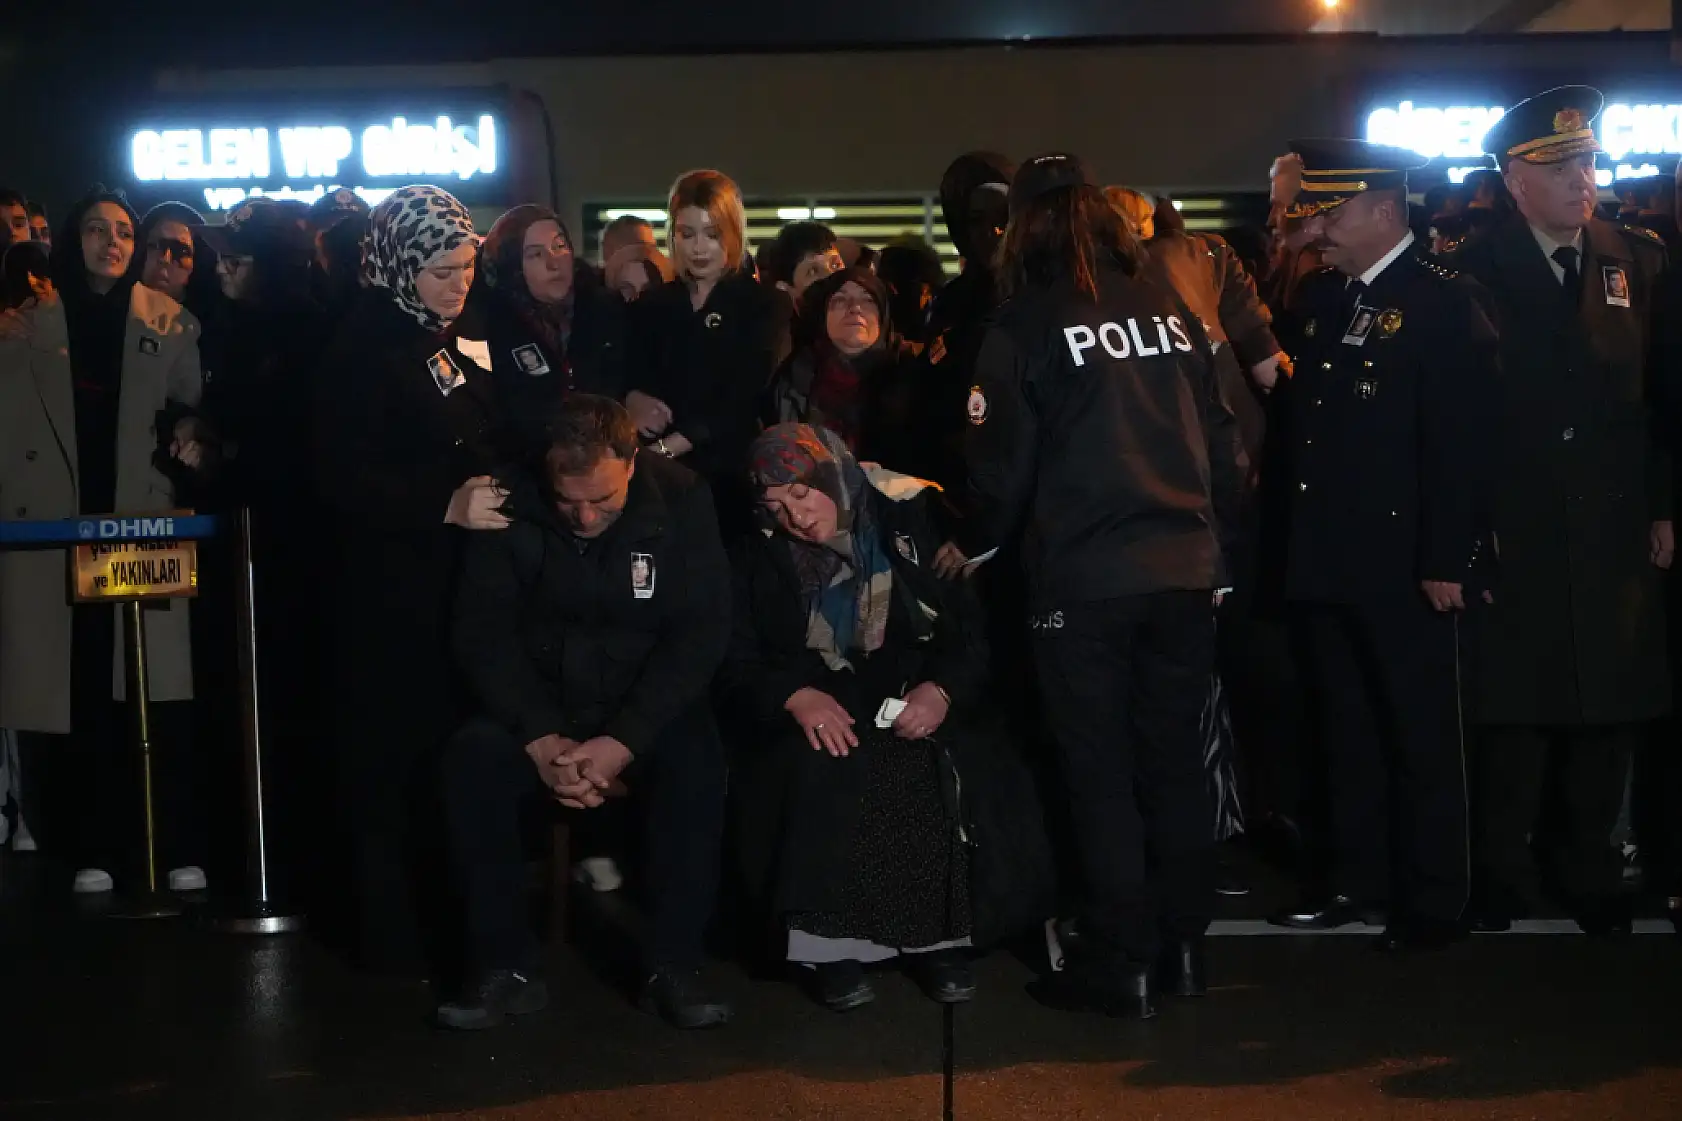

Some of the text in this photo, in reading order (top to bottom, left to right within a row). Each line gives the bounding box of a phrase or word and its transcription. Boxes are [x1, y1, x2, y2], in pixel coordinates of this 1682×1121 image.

[132, 128, 270, 180] GELEN
[279, 126, 353, 177] VIP
[111, 558, 181, 586] YAKINLARI
